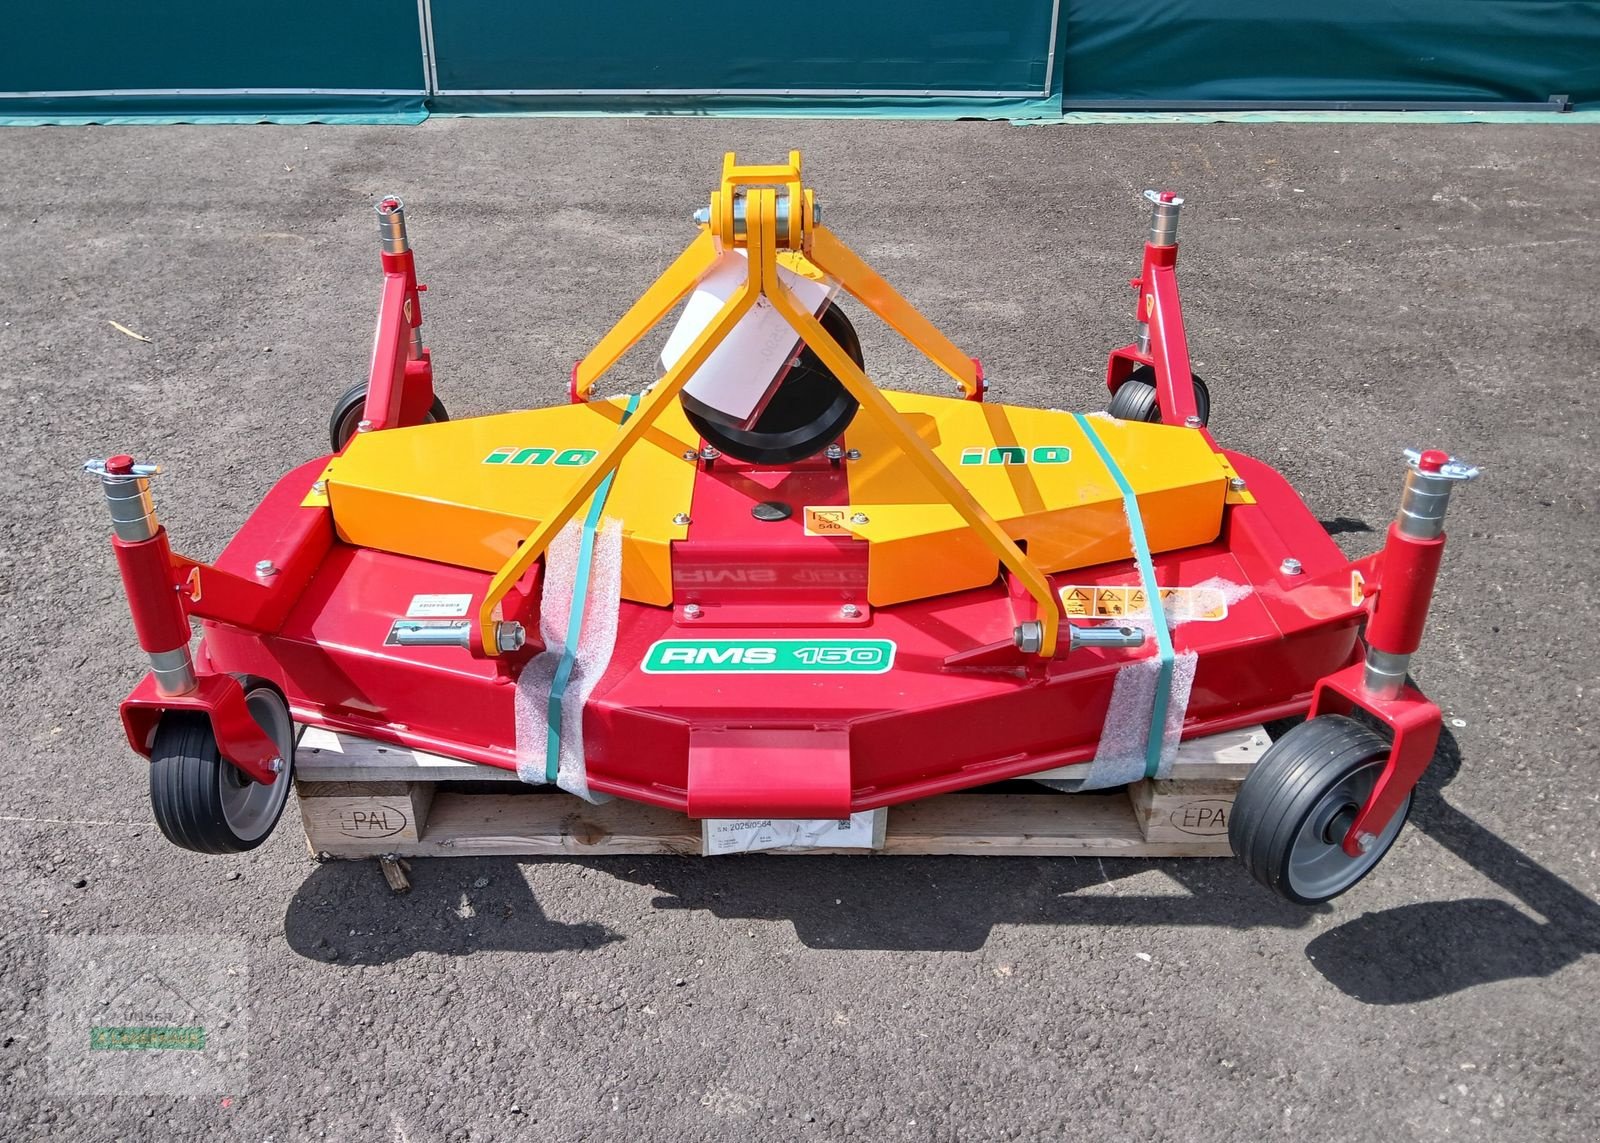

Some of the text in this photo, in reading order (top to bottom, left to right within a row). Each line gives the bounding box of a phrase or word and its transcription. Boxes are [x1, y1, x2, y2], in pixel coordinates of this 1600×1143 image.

[482, 447, 599, 466] ino
[960, 446, 1072, 466] ino
[660, 647, 883, 665] RMS 150
[730, 820, 772, 831] 2025/0584
[1183, 808, 1226, 828] EPA
